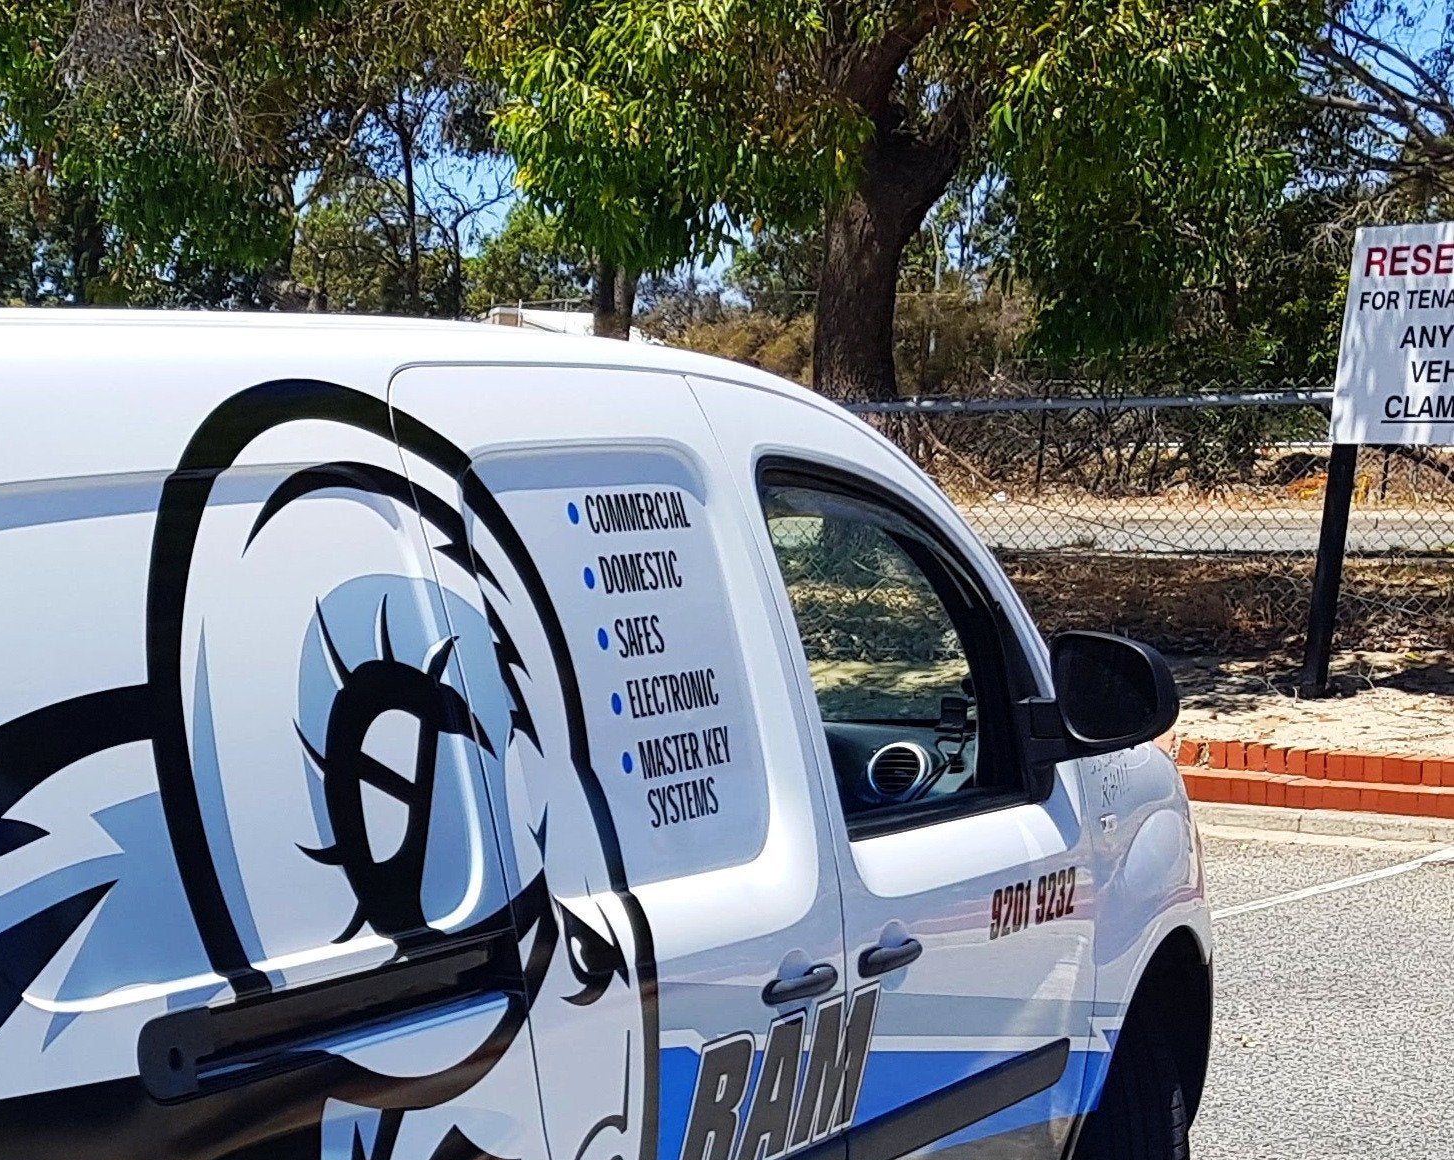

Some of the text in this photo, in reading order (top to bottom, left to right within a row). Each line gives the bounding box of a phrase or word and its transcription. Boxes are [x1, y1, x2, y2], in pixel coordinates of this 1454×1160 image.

[1359, 291, 1400, 311] FOR
[1399, 325, 1454, 348] ANY
[584, 491, 691, 534] COMMERCIAL
[598, 550, 682, 594] DOMESTIC
[614, 614, 665, 658] SAFES
[626, 668, 719, 719] ELECTRONIC
[638, 725, 731, 780] MASTER KEY
[647, 776, 719, 828] SYSTEMS
[989, 866, 1076, 940] 9201 9232
